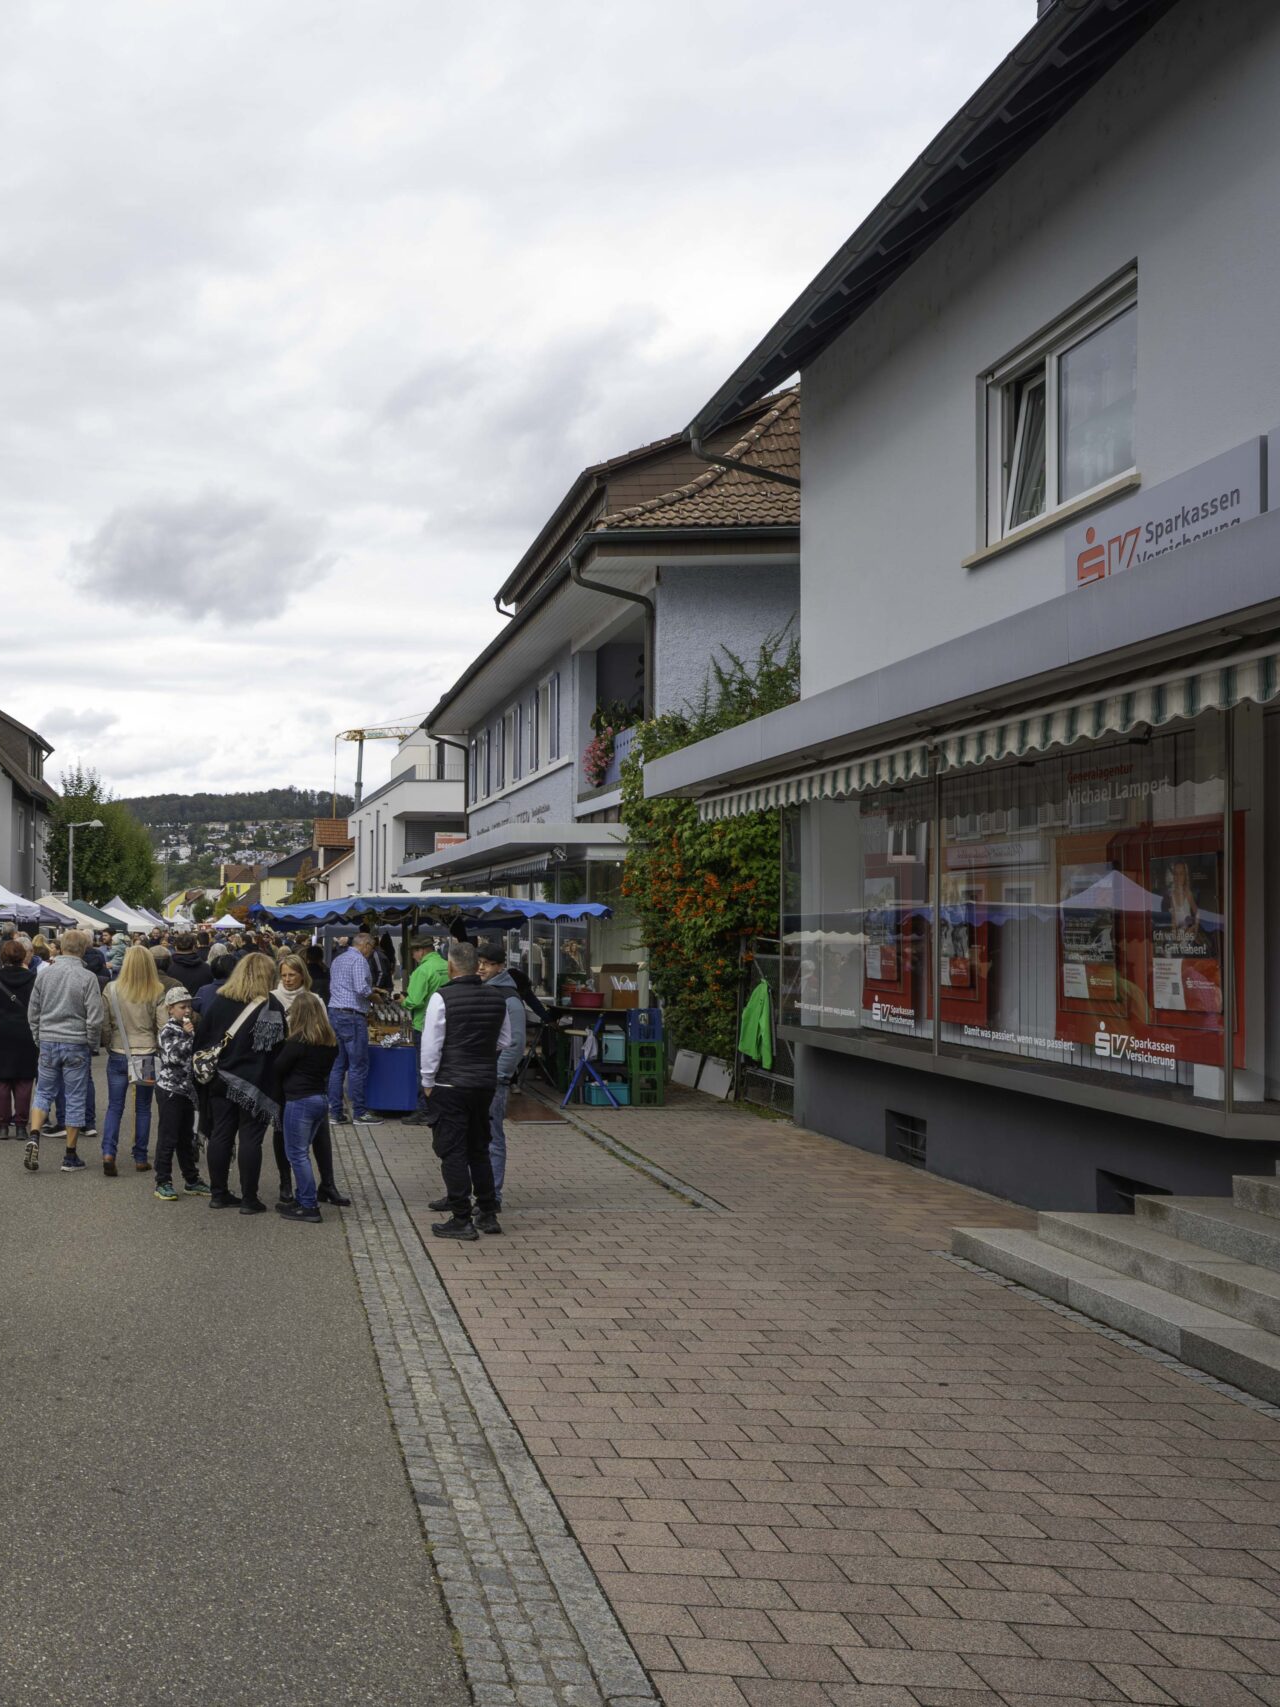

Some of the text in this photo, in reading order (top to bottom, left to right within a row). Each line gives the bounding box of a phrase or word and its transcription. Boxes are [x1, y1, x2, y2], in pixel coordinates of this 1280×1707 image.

[1144, 487, 1241, 545] Sparkassen
[1066, 762, 1134, 784] Generalagentur
[1067, 775, 1170, 807] Michael Lampert
[964, 1024, 1075, 1052] Damit was passiert, wenn was passiert.
[1095, 1021, 1128, 1059] SV
[1129, 1036, 1175, 1054] Sparkassen
[1125, 1049, 1175, 1070] Versicherung
